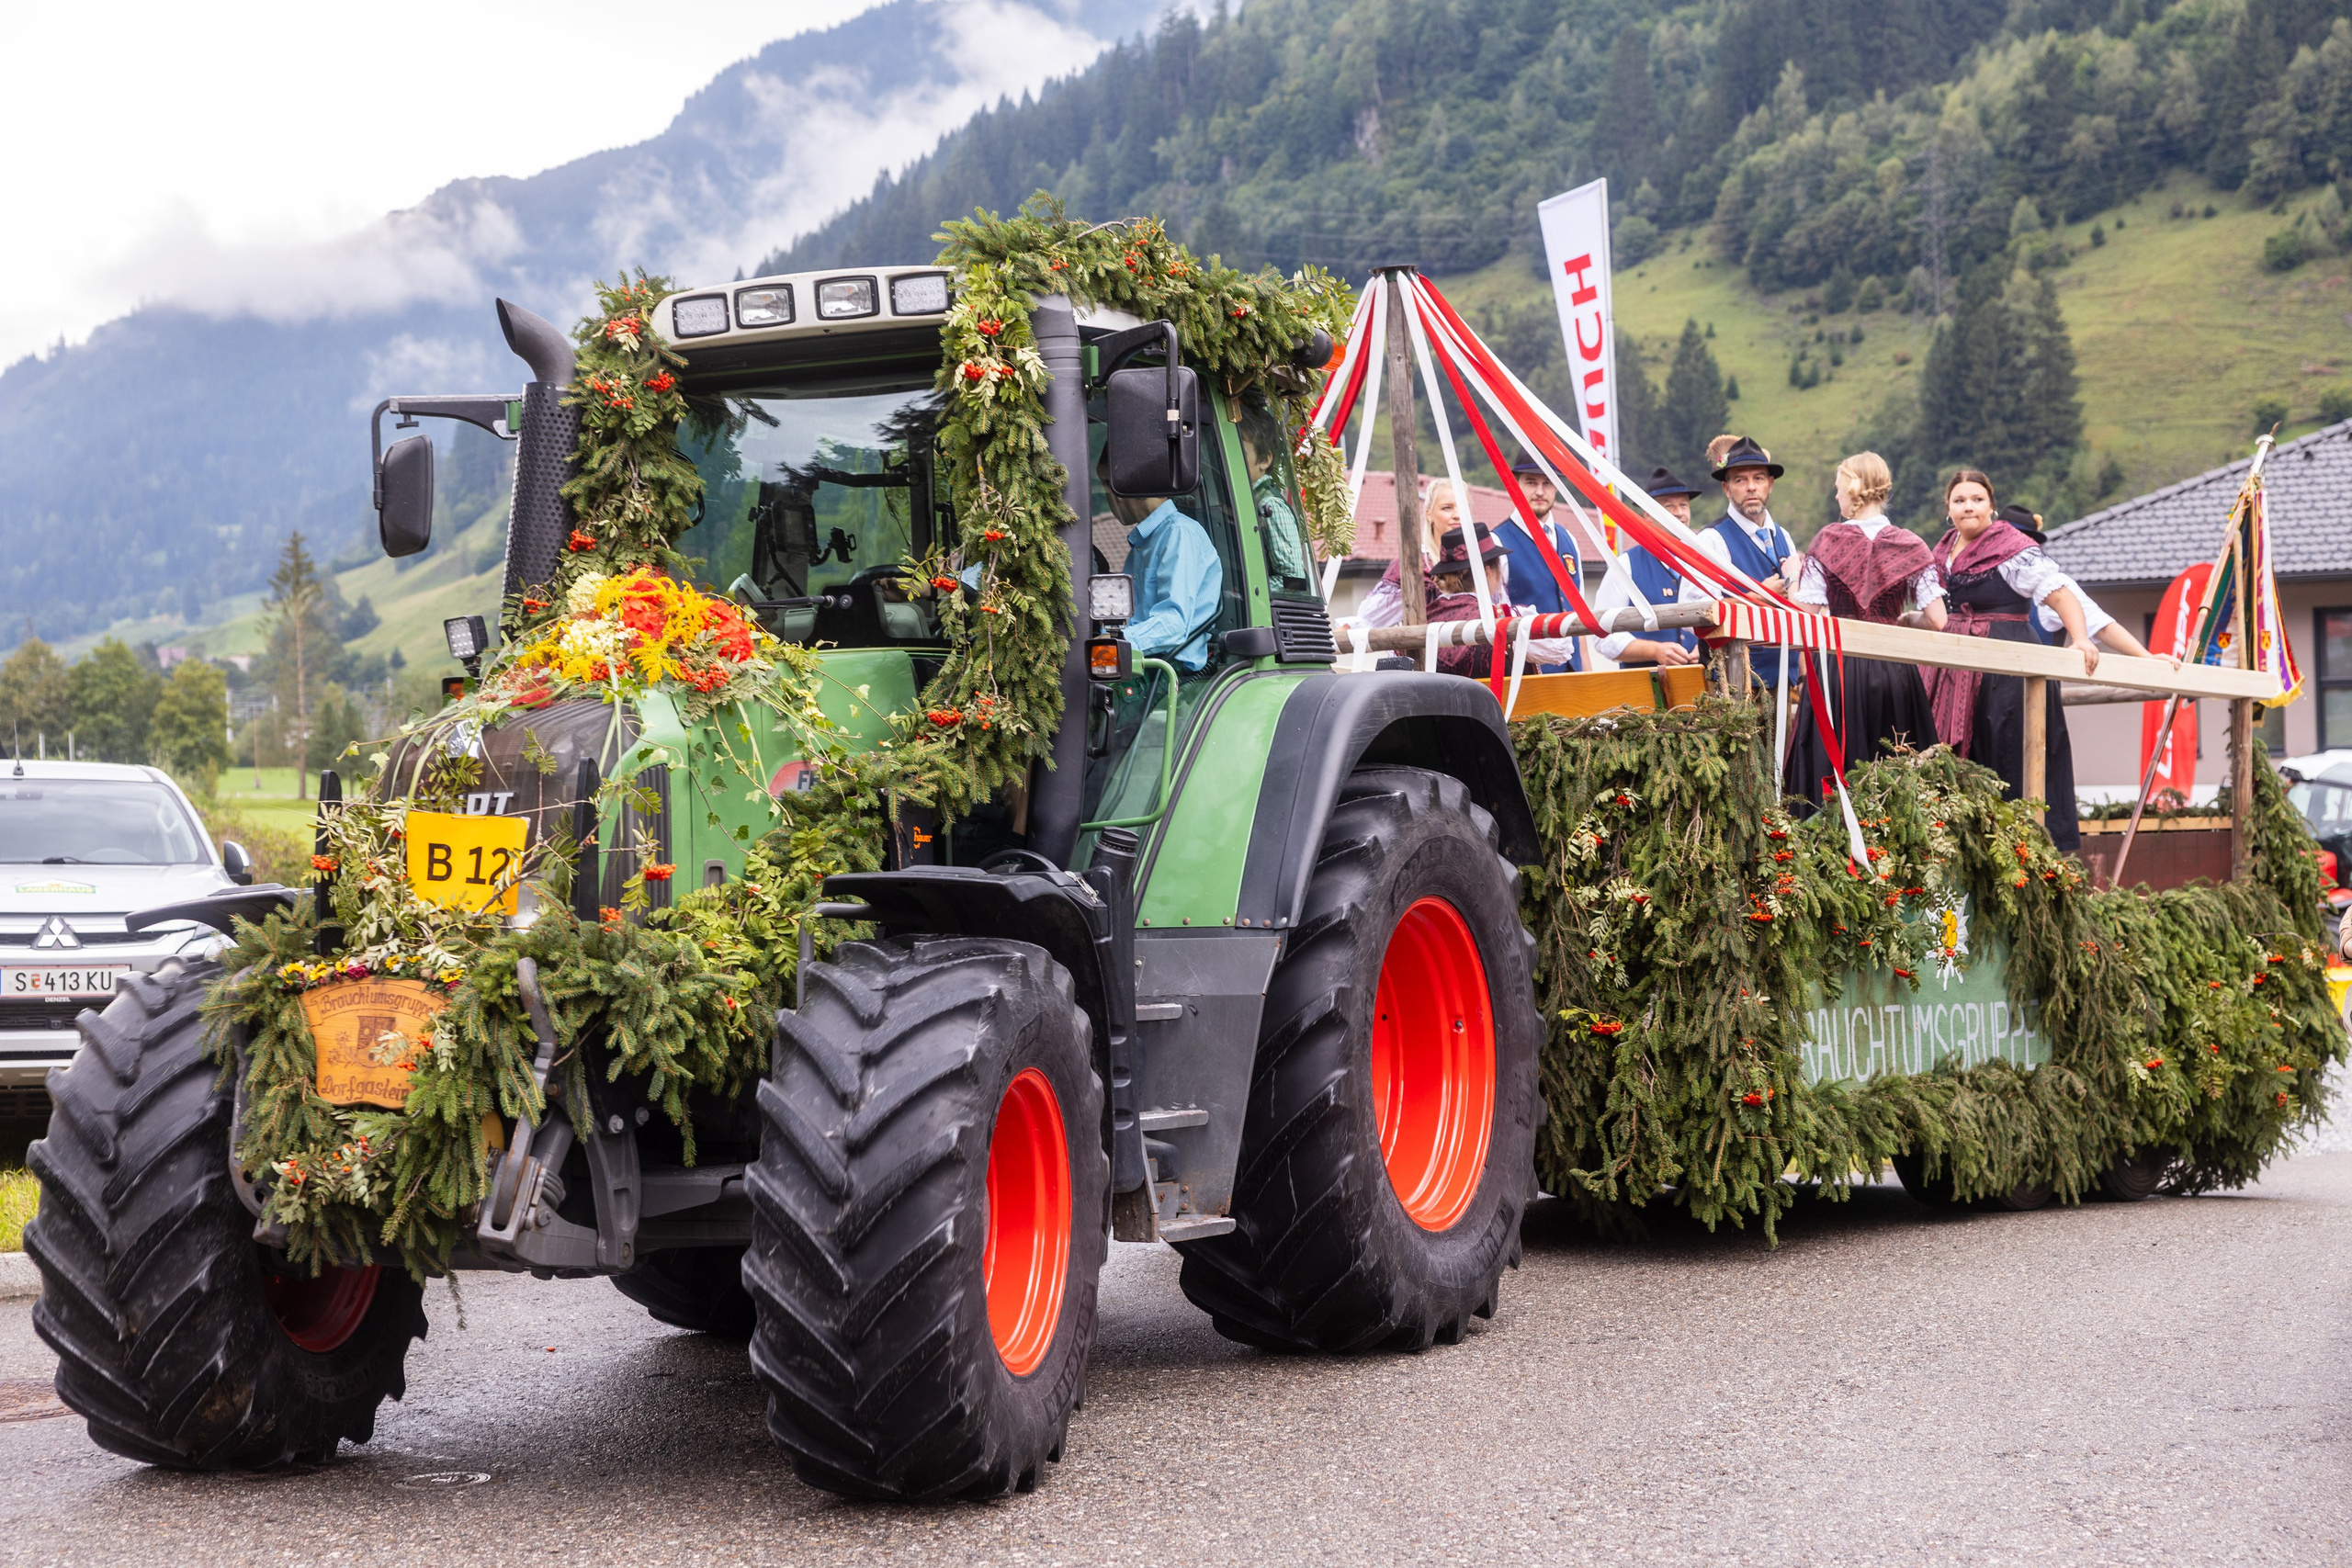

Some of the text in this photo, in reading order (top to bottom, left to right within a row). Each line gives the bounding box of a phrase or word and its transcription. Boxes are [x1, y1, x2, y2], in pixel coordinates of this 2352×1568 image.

[426, 842, 511, 886] B 12
[15, 971, 112, 991] S 413 KU
[1791, 998, 2039, 1086] RAUCHTUMSGRUPPE
